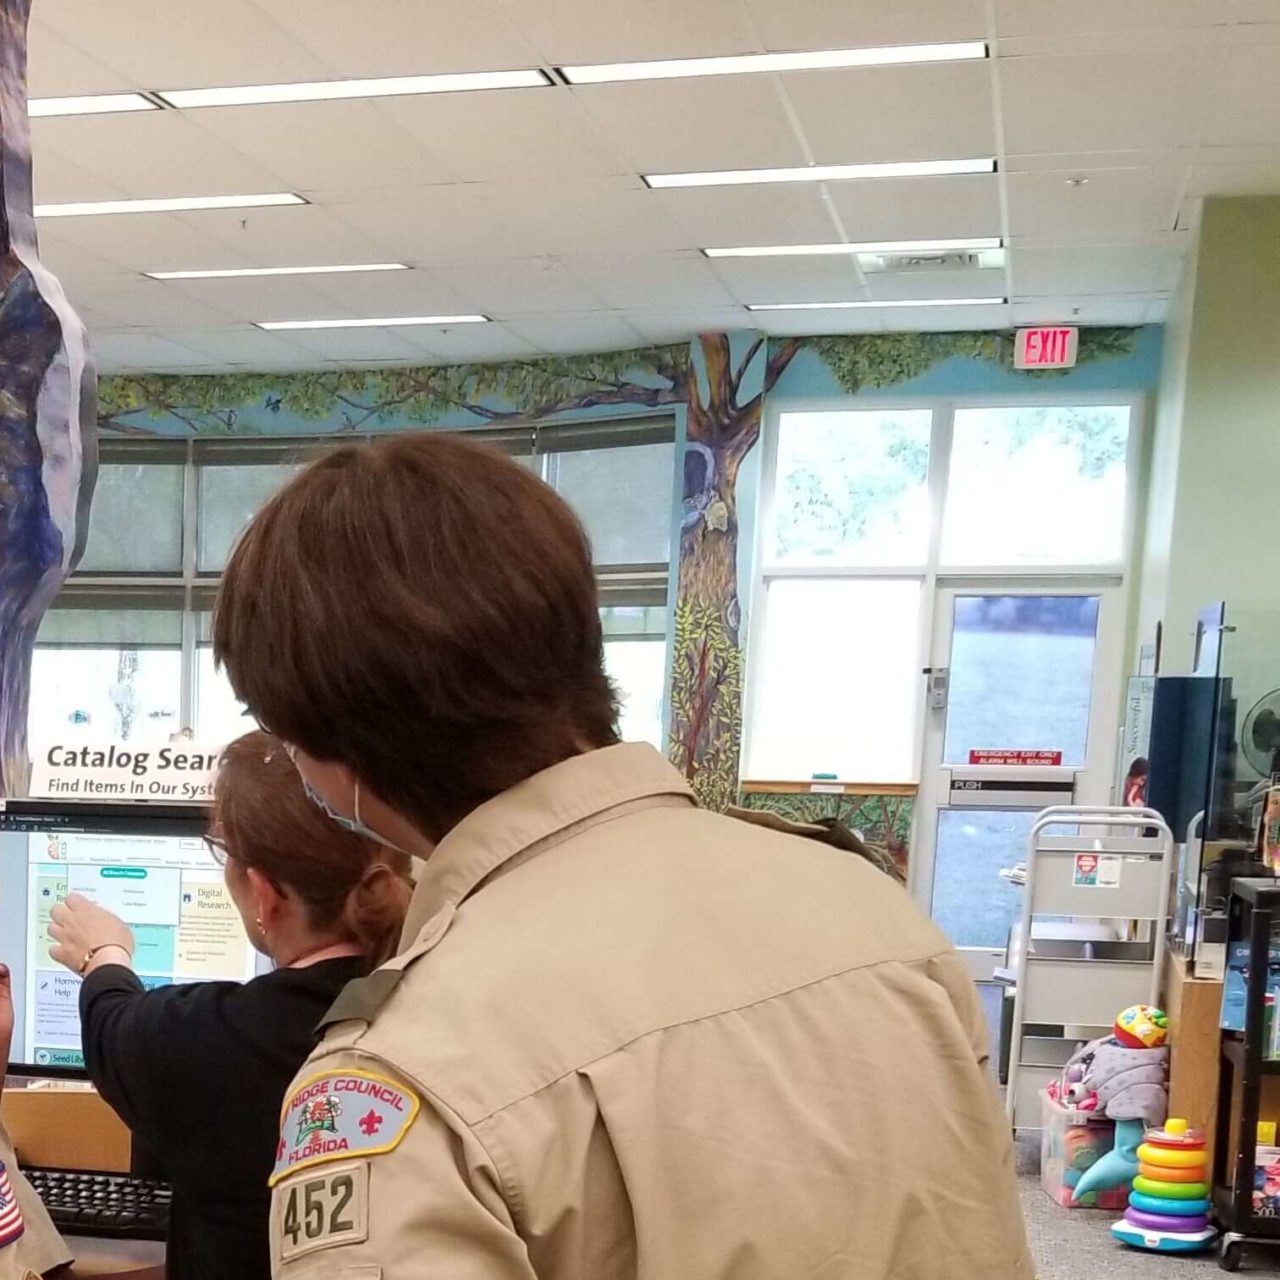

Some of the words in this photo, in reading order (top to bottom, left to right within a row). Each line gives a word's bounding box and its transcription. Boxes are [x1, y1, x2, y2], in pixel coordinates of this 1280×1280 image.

[1024, 330, 1070, 363] EXIT
[47, 745, 150, 776] Catalog
[48, 778, 79, 793] Find
[83, 779, 126, 794] Items
[130, 780, 144, 794] In
[148, 781, 178, 795] Our
[181, 782, 216, 799] Syst
[197, 888, 223, 899] Digital
[197, 900, 232, 910] Research
[54, 988, 71, 998] Help
[53, 1054, 70, 1062] Seed
[333, 1079, 404, 1112] COUNCIL
[288, 1137, 349, 1165] FLORIDA
[283, 1174, 354, 1246] 452
